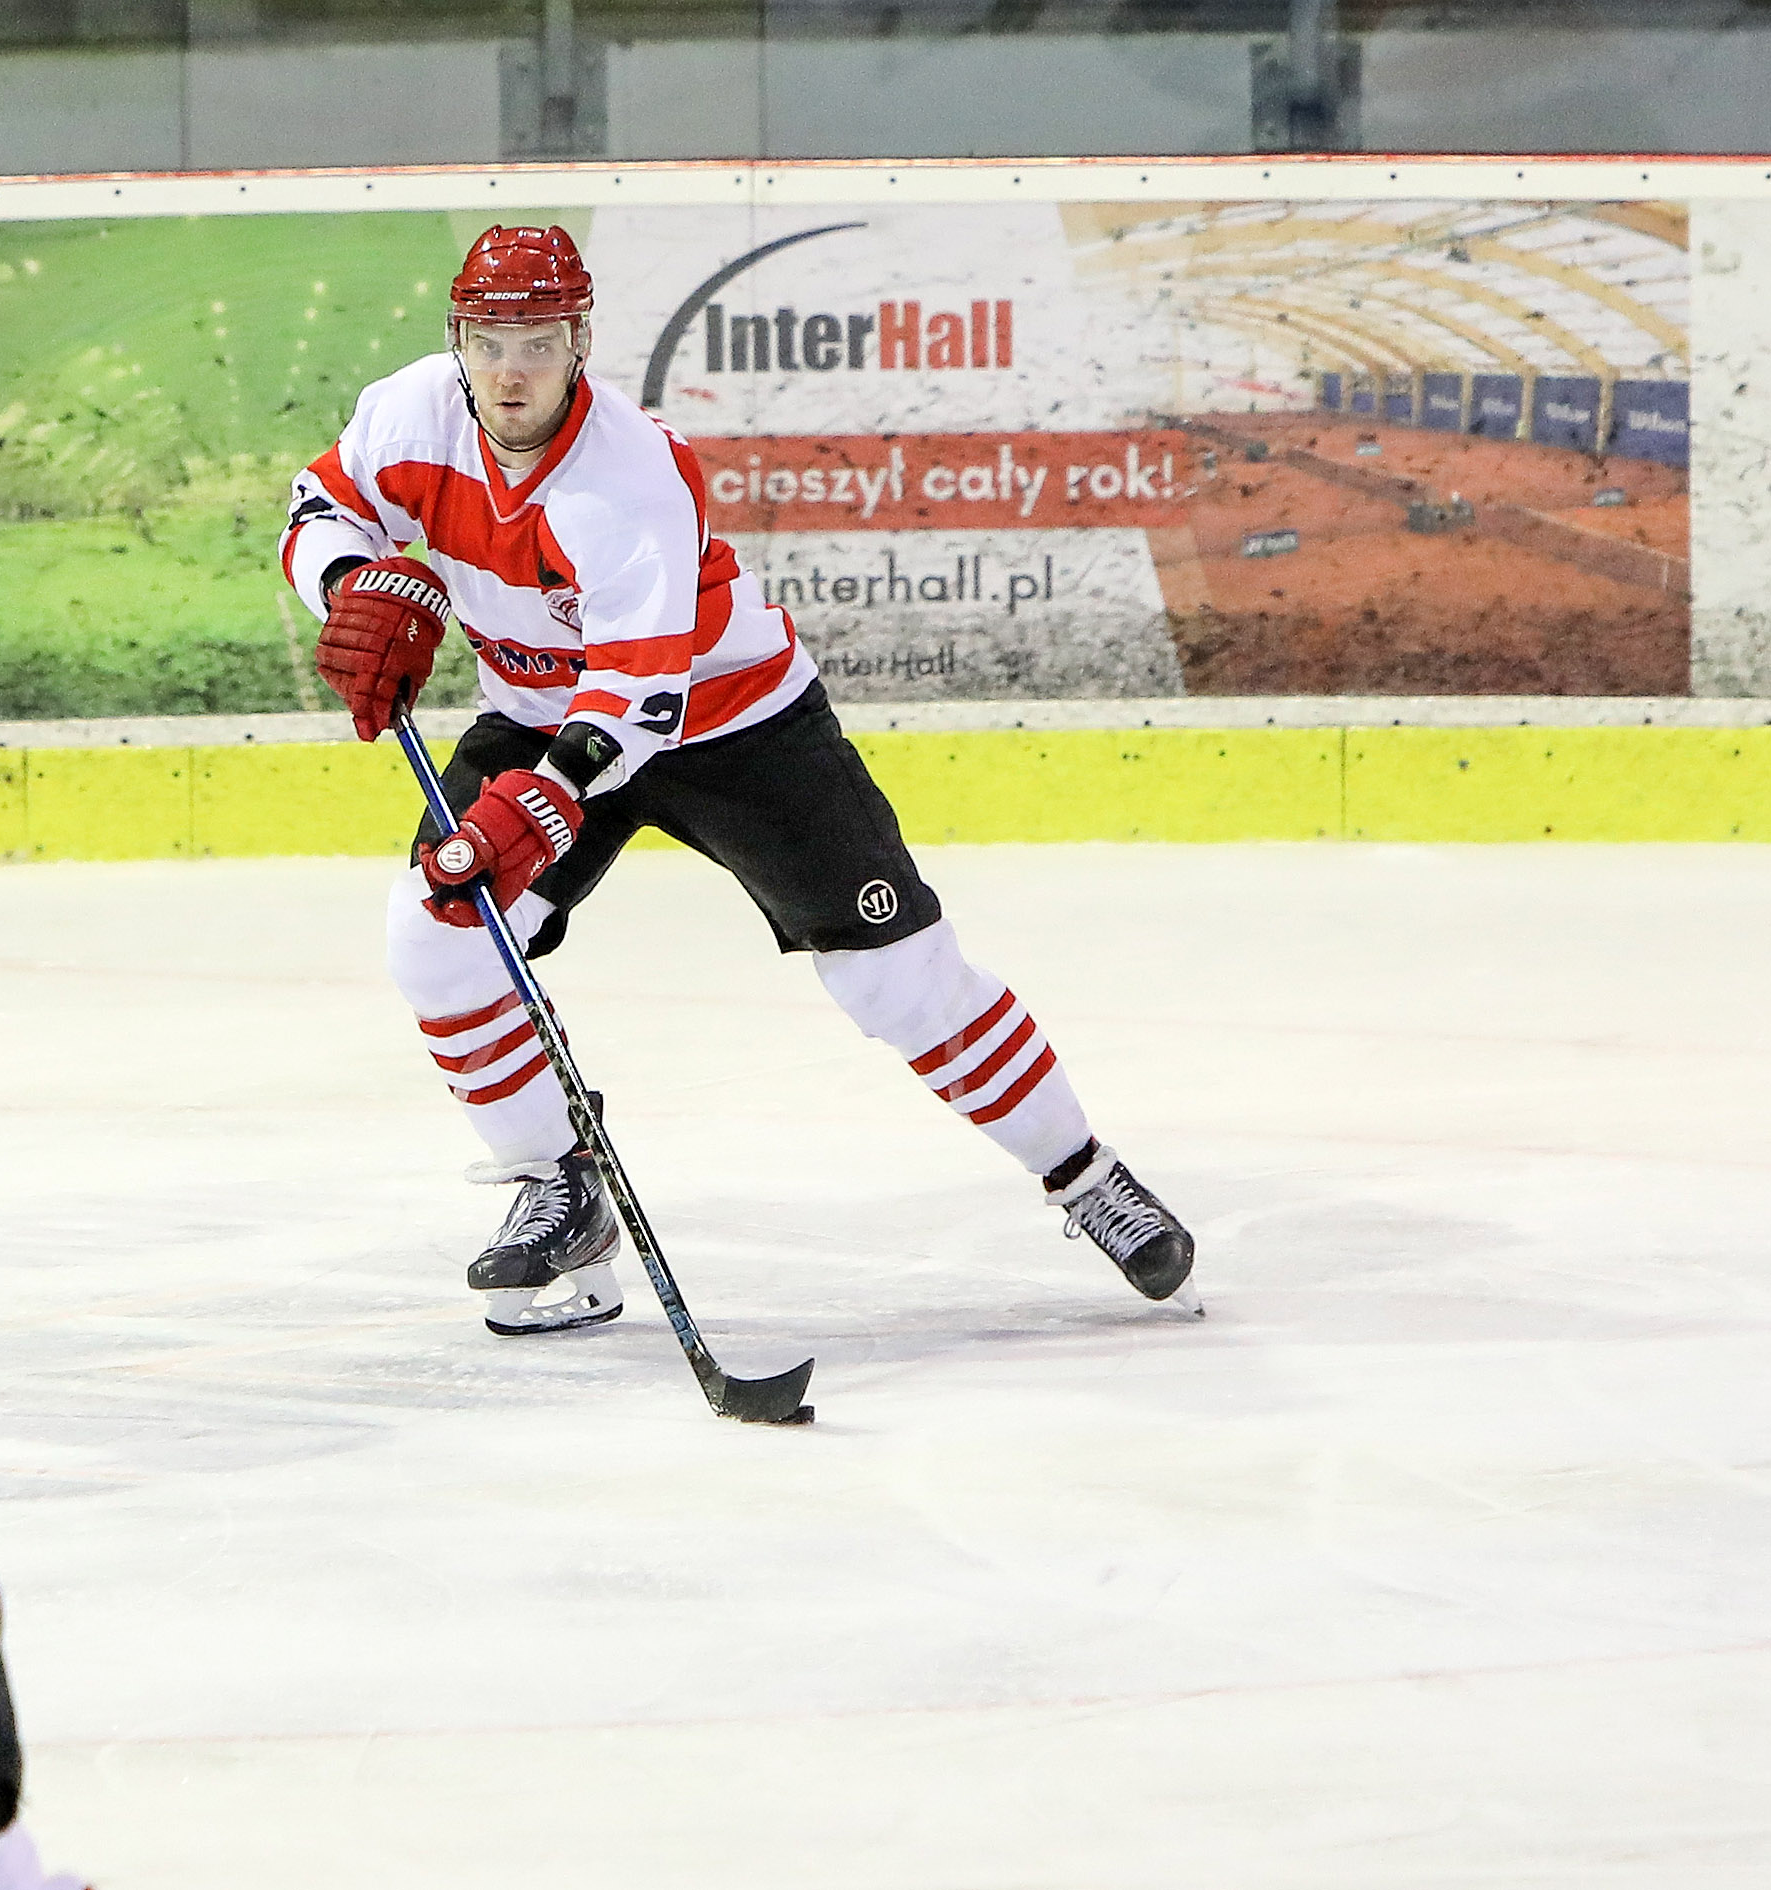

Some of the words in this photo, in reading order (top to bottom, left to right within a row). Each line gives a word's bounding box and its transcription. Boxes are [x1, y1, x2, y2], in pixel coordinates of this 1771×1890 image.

[705, 298, 1013, 373] InterHall
[709, 444, 905, 520] cieszył
[922, 443, 1048, 518] cały
[1066, 442, 1175, 501] rok!
[763, 552, 1052, 615] interhall.pl
[816, 640, 956, 681] nterHall
[632, 691, 684, 736] 2
